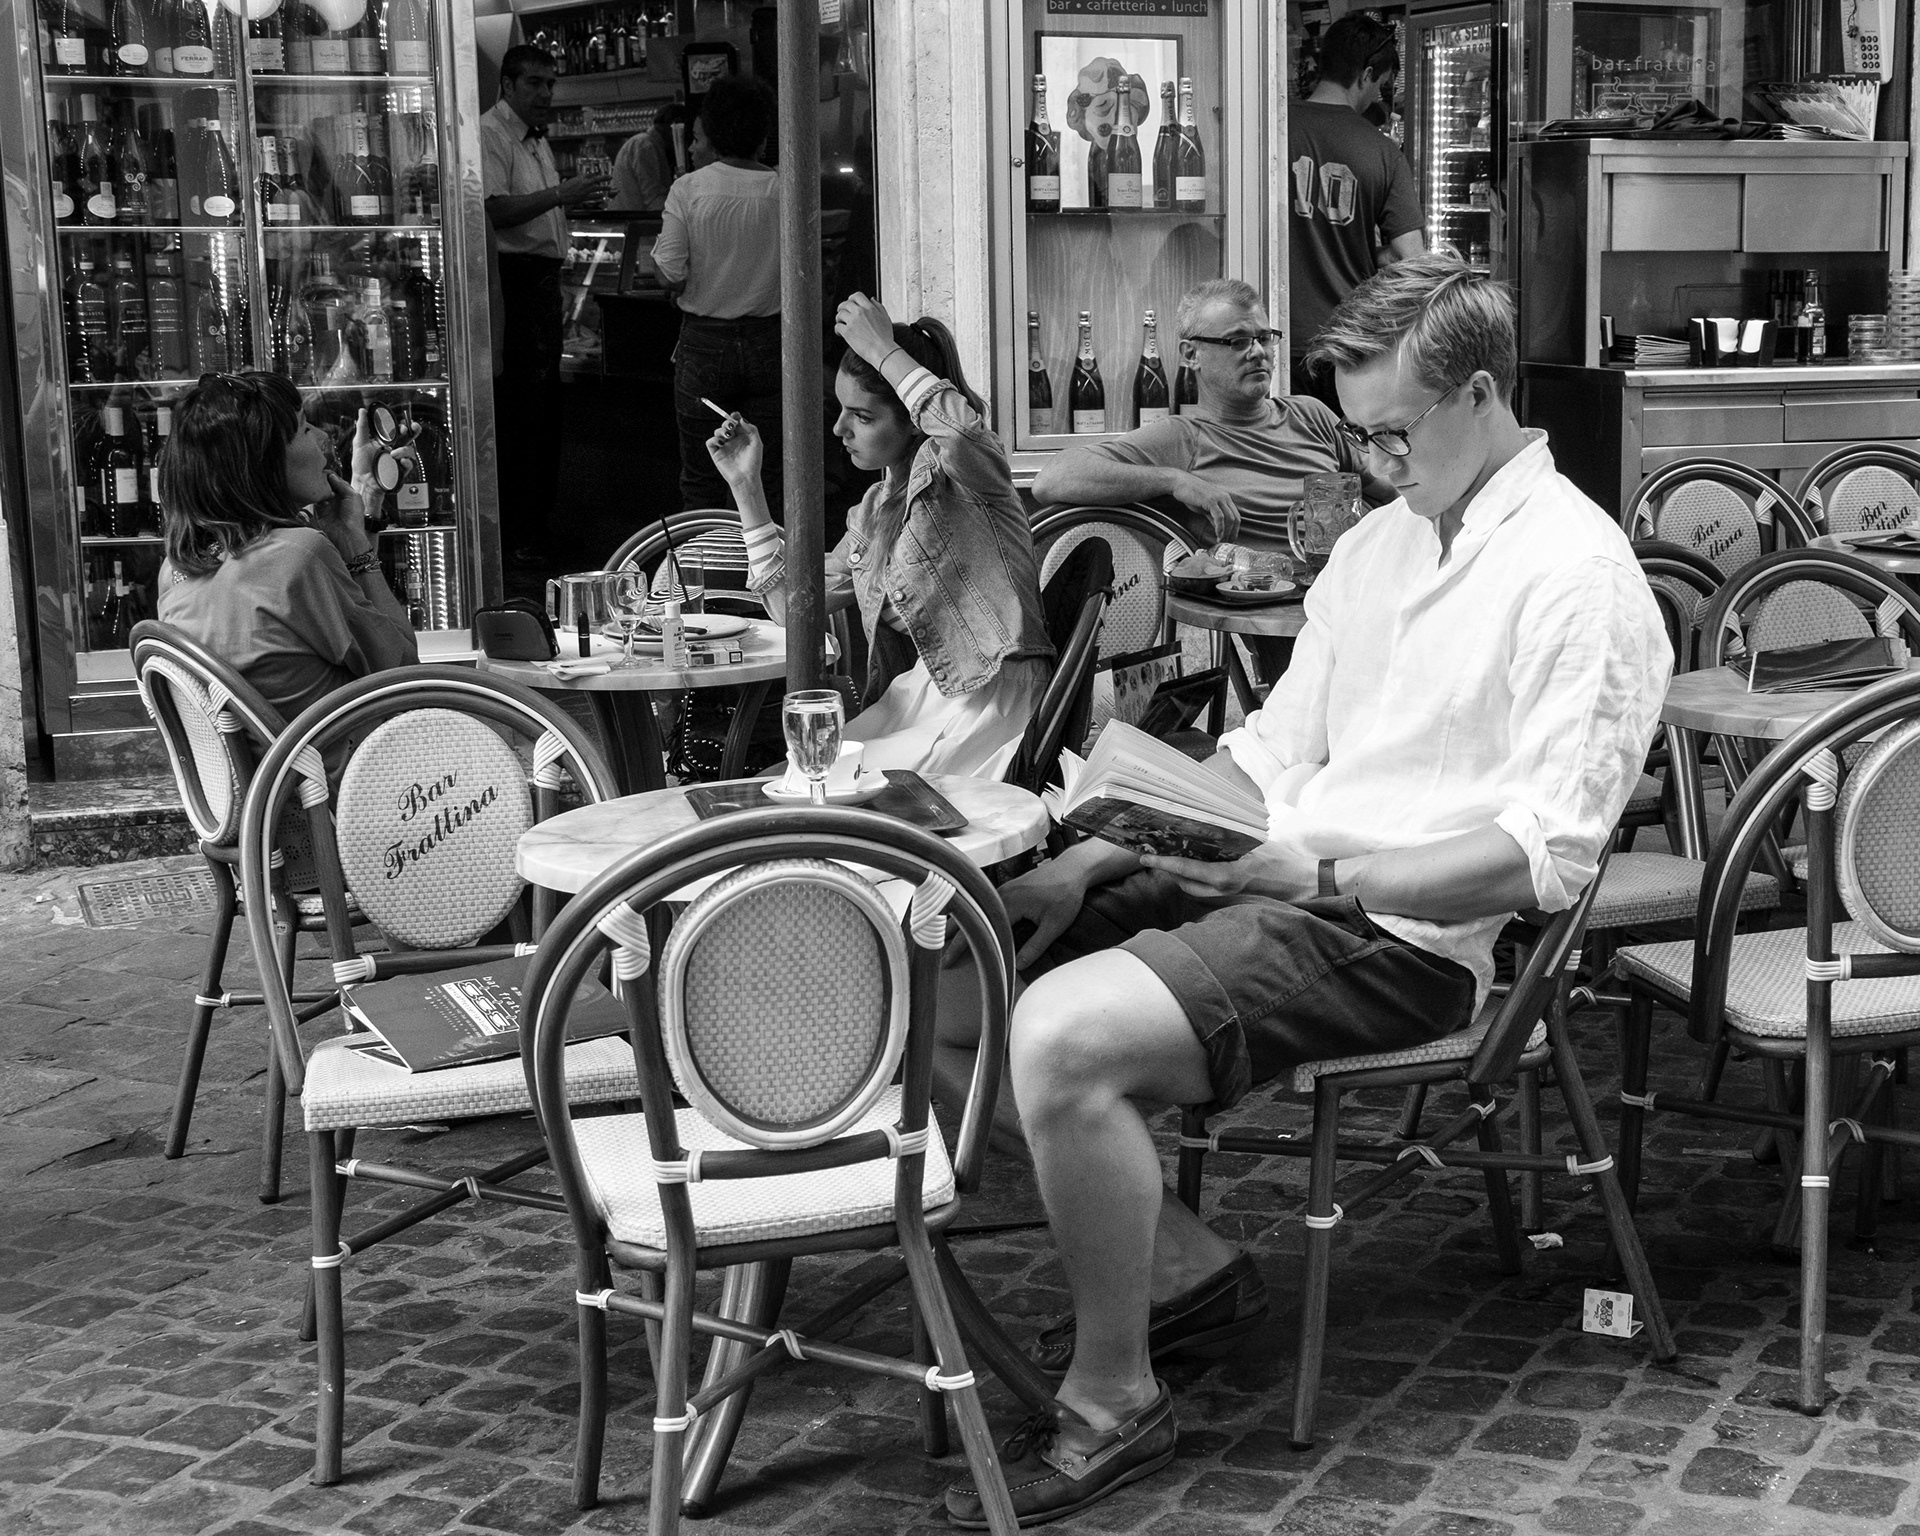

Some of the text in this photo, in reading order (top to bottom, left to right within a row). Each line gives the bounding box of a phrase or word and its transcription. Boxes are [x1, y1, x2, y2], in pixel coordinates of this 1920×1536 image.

[1049, 0, 1208, 13] bar caffetteria lunch
[1592, 54, 1626, 71] bar
[1292, 155, 1358, 226] 10
[1858, 501, 1888, 531] Bar
[1691, 520, 1721, 548] Bar
[1708, 528, 1743, 560] ttina
[397, 769, 458, 822] Bar
[383, 782, 500, 880] Frattina
[482, 976, 500, 988] bar
[499, 992, 521, 1013] fratt
